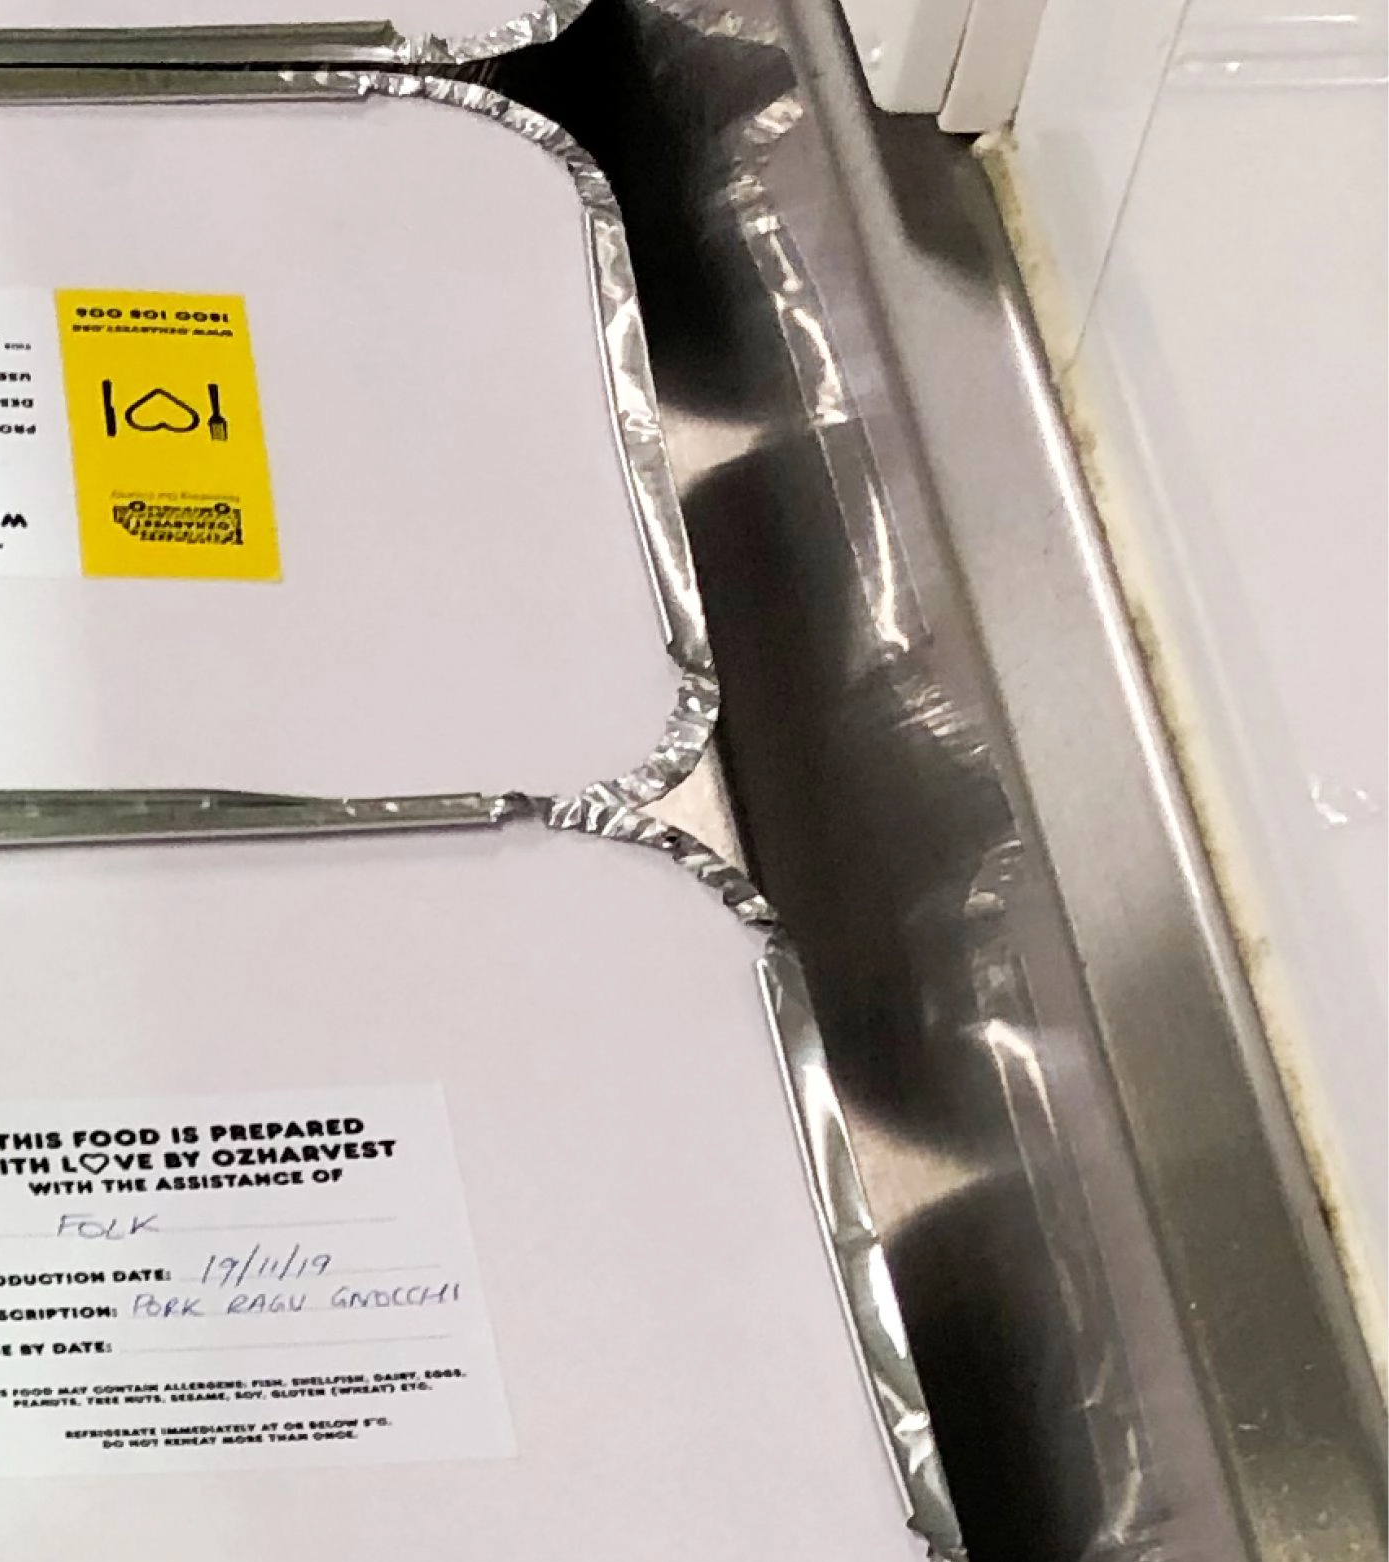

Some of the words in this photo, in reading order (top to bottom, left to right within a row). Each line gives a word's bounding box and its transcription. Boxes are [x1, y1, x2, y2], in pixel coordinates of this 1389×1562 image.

[76, 308, 122, 319] 006
[130, 309, 166, 320] 108
[175, 311, 228, 323] 1800
[73, 1128, 160, 1148] FOOD
[171, 1126, 199, 1144] IS
[210, 1118, 364, 1142] PREPARED
[164, 1151, 200, 1169] BY
[212, 1140, 396, 1167] OZHARVEST
[29, 1180, 93, 1195] WITH
[101, 1178, 146, 1193] THE
[156, 1171, 304, 1191] ASSISTANCE
[312, 1168, 342, 1183] OF
[57, 1213, 160, 1239] FOLK
[112, 1268, 170, 1282] DATE:
[201, 1244, 331, 1287] 19/11/19
[227, 1292, 307, 1315] RAGU
